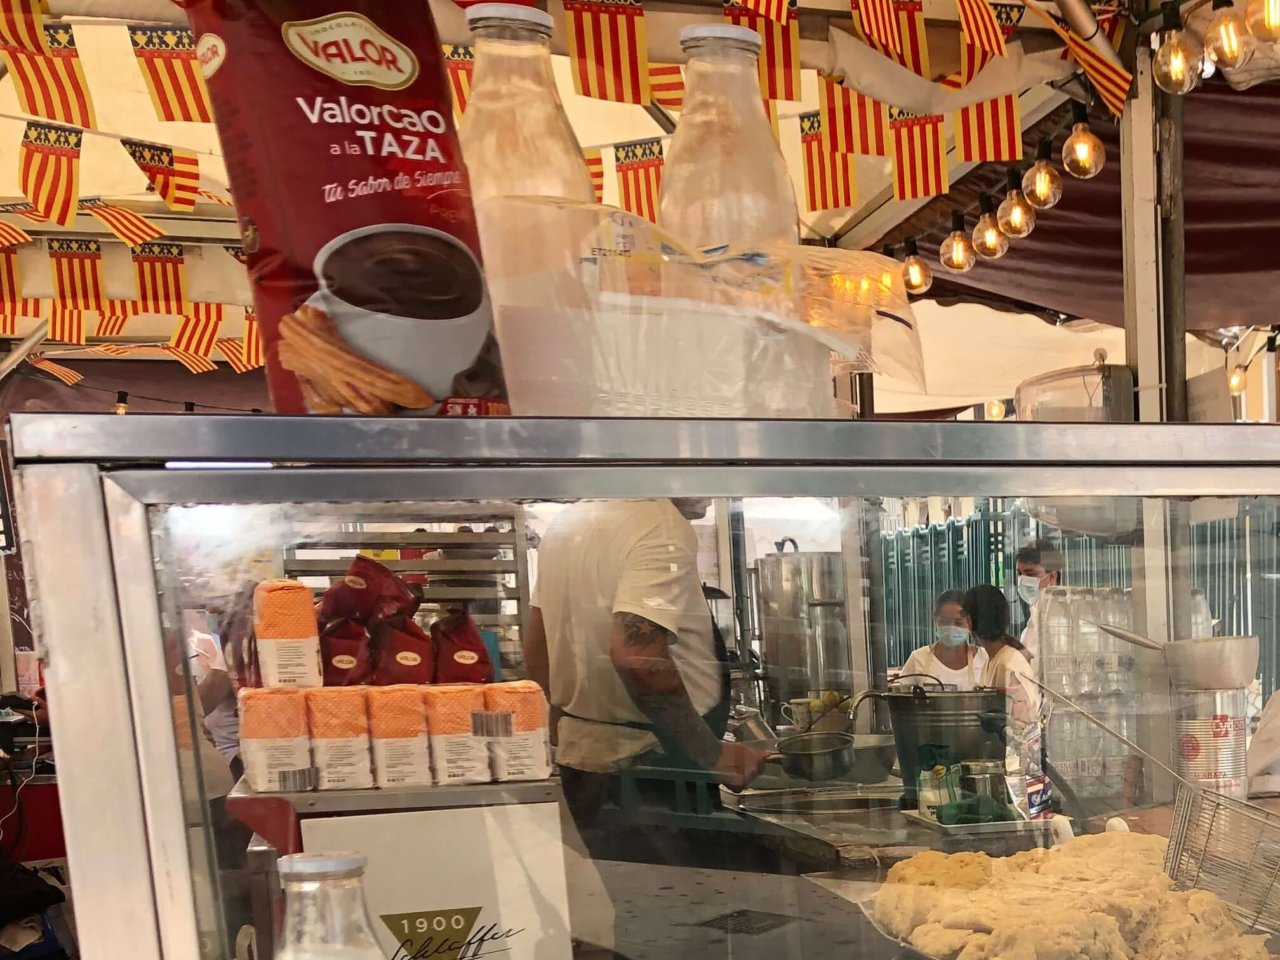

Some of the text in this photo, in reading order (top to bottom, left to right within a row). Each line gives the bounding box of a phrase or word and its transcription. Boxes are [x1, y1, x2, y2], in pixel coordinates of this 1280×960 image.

[295, 31, 405, 74] VALOR
[329, 130, 447, 164] a la TAZA
[322, 182, 345, 203] Tu
[348, 177, 392, 198] Sabor
[393, 171, 411, 190] de
[400, 914, 466, 934] 1900
